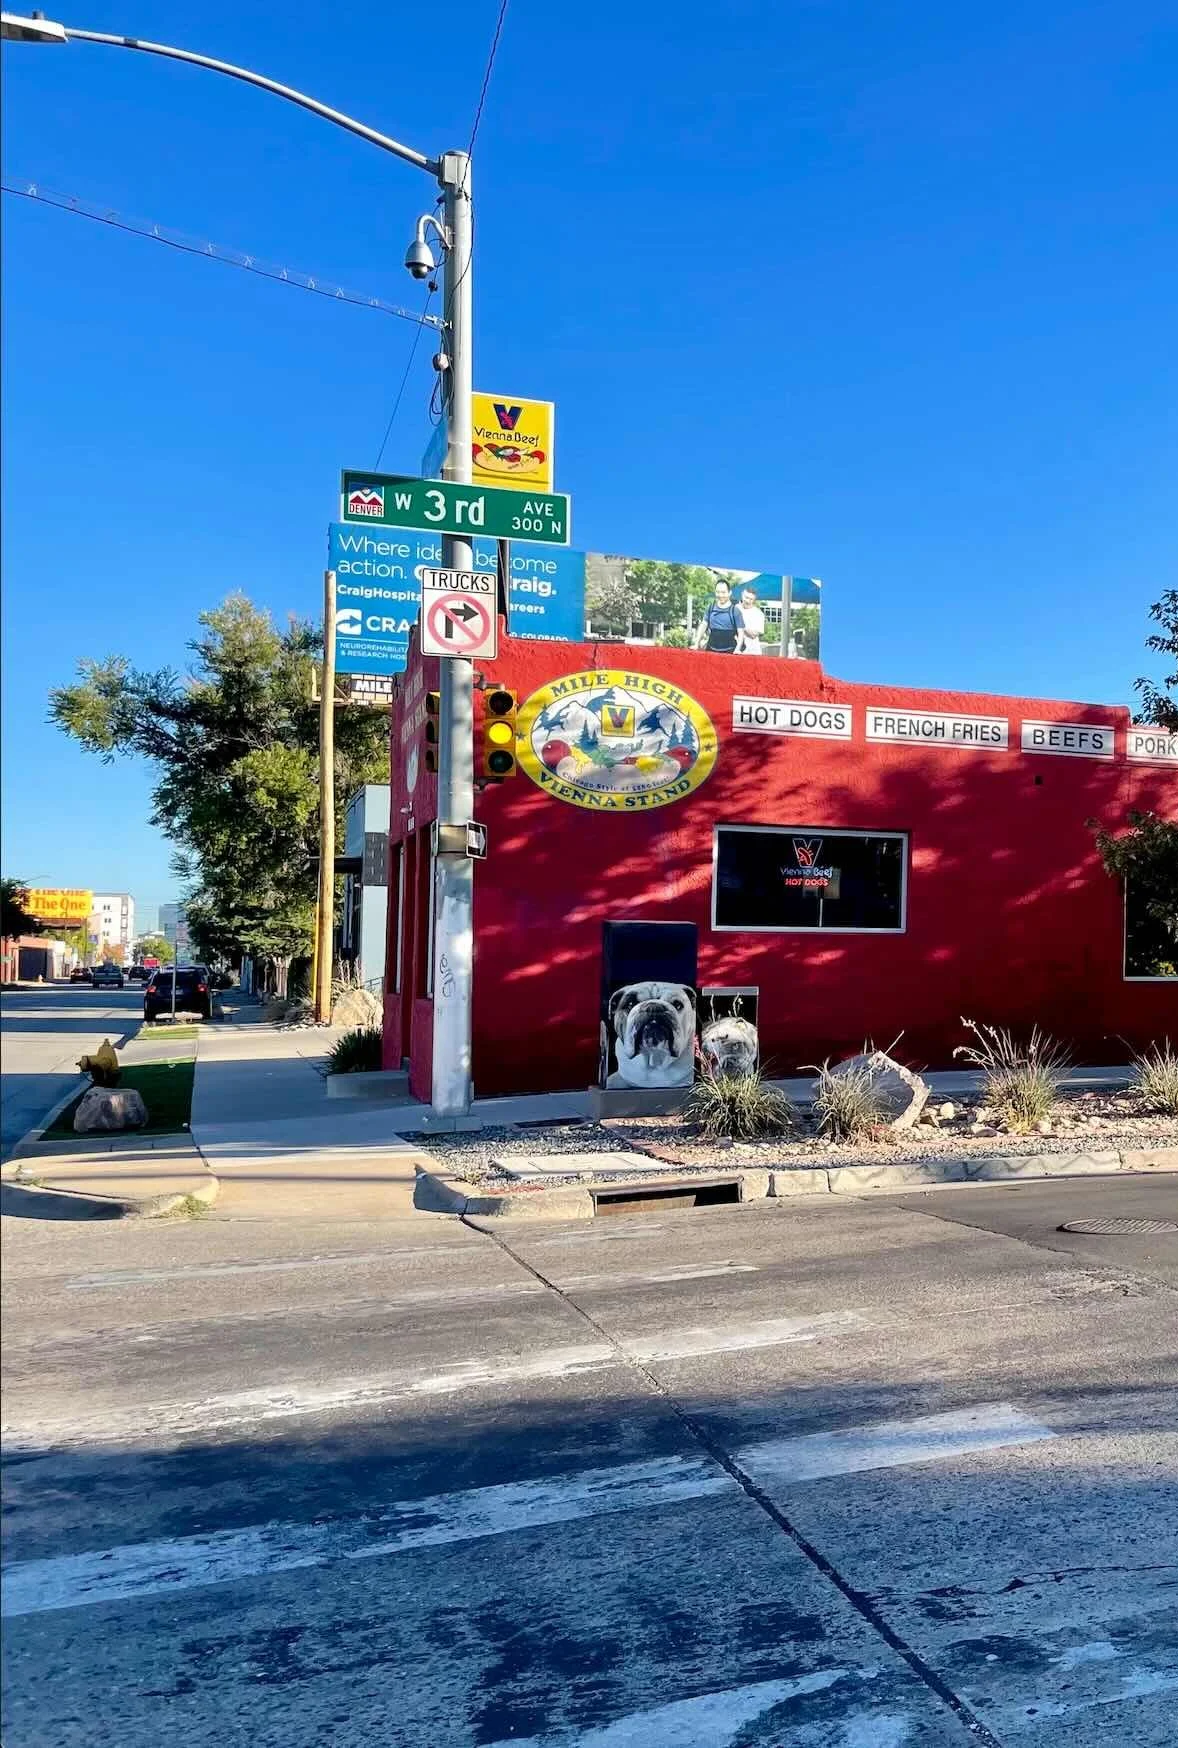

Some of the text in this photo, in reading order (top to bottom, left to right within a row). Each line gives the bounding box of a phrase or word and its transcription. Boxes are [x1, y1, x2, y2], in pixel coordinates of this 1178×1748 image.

[474, 426, 540, 447] Vienna Beef
[349, 503, 384, 516] DENVER
[394, 490, 554, 526] W 3rd AVE
[511, 517, 561, 535] 300 N
[339, 533, 557, 574] Where ide beome
[338, 559, 407, 580] action.
[510, 576, 557, 597] raig.
[430, 571, 489, 592] TRUCKS
[366, 615, 412, 633] CRA
[340, 642, 407, 653] NEUROREHABILIT
[551, 674, 684, 705] MILE HIGH
[740, 705, 845, 730] HOT DOGS
[874, 716, 1001, 743] FRENCH FRIES
[1033, 729, 1103, 749] BEEFS
[1135, 736, 1176, 755] PORK
[540, 771, 617, 807] VIENNA
[624, 779, 690, 807] STAND
[780, 866, 832, 878] Vienna Beef
[785, 878, 829, 887] HOT DOGS
[33, 897, 87, 910] The One
